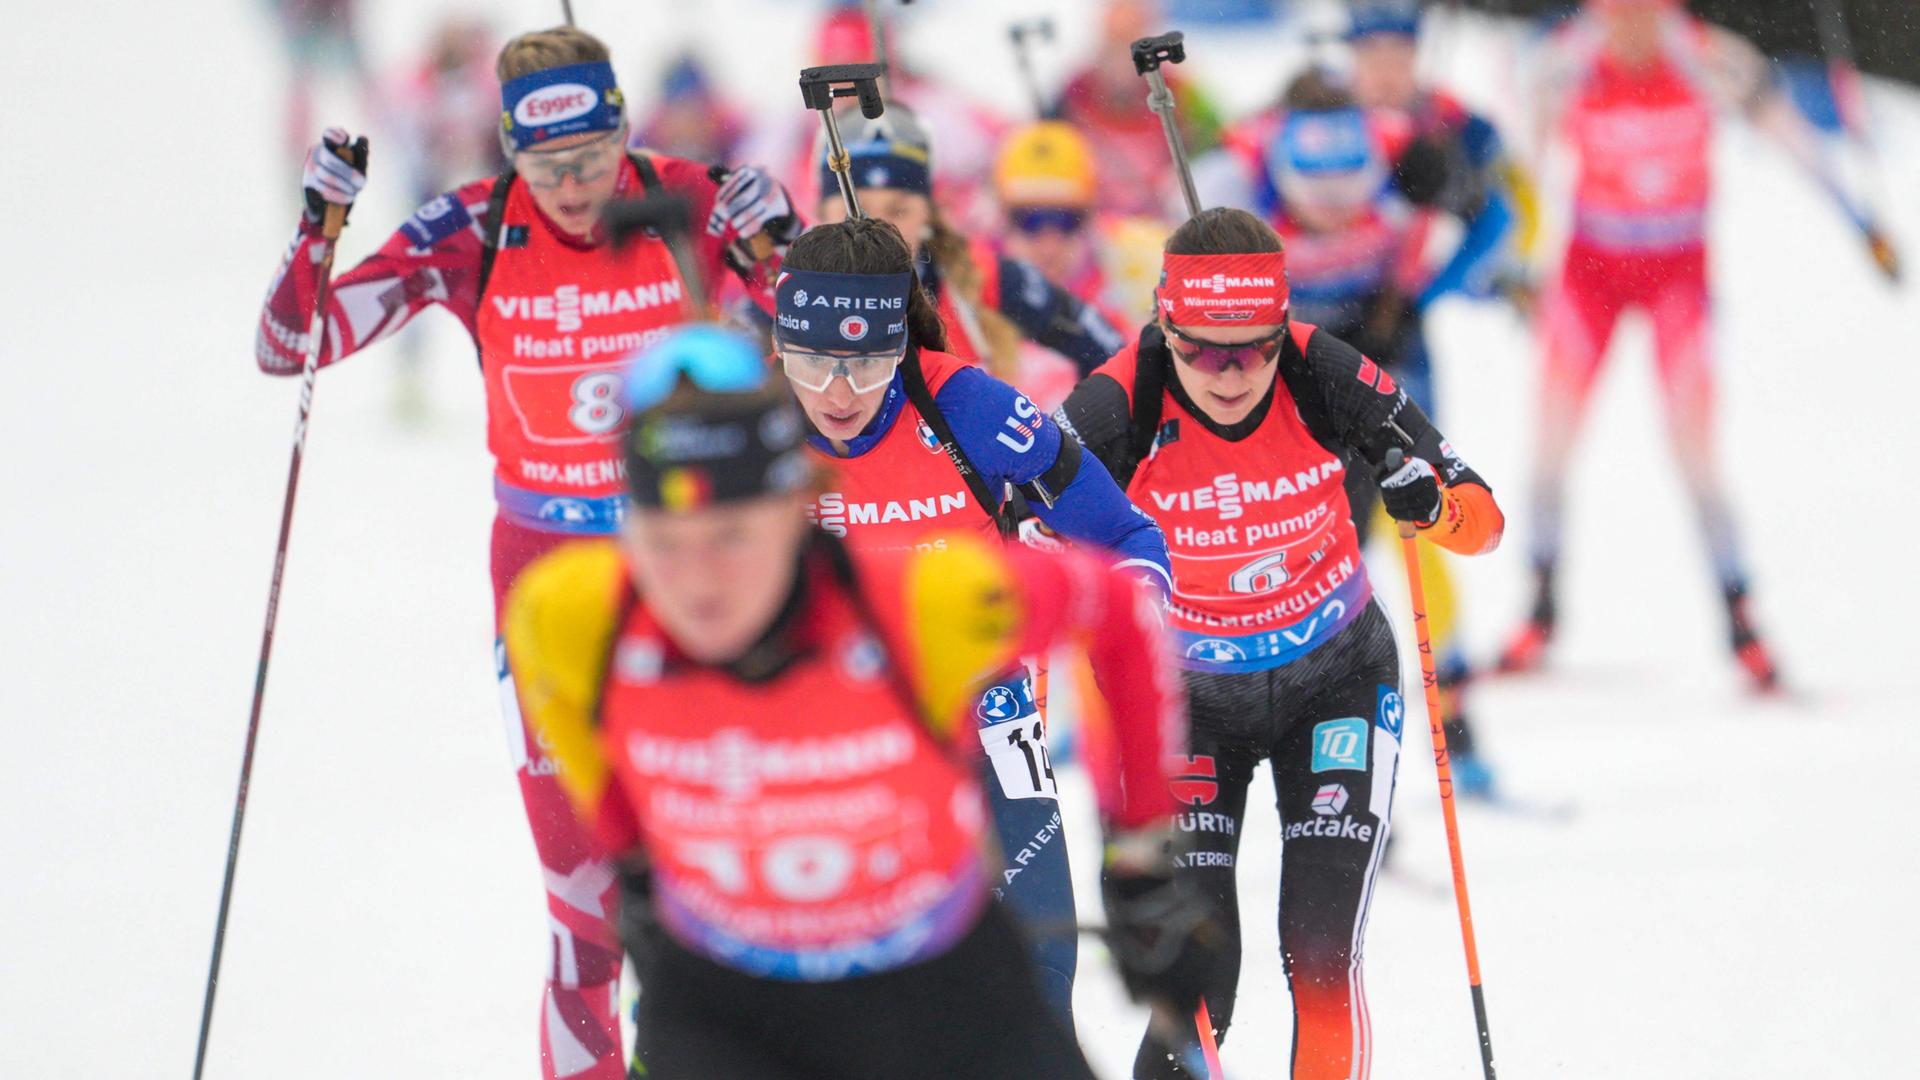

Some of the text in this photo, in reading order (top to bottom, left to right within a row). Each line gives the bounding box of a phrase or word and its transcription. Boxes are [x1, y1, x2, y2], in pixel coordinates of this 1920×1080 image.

[493, 279, 682, 332] VIESSMANN
[811, 295, 903, 309] ARIENS
[1183, 273, 1275, 293] VIESSMANN
[513, 334, 574, 358] Heat
[570, 371, 627, 434] 8
[1150, 458, 1343, 521] VIESSMANN
[804, 491, 967, 538] ESSMANN
[1174, 524, 1239, 548] Heat
[1246, 502, 1328, 545] pumps
[1229, 550, 1290, 594] 6
[1320, 726, 1358, 764] TQ
[1170, 812, 1235, 835] ÜRTH
[1004, 811, 1062, 885] ARIENS
